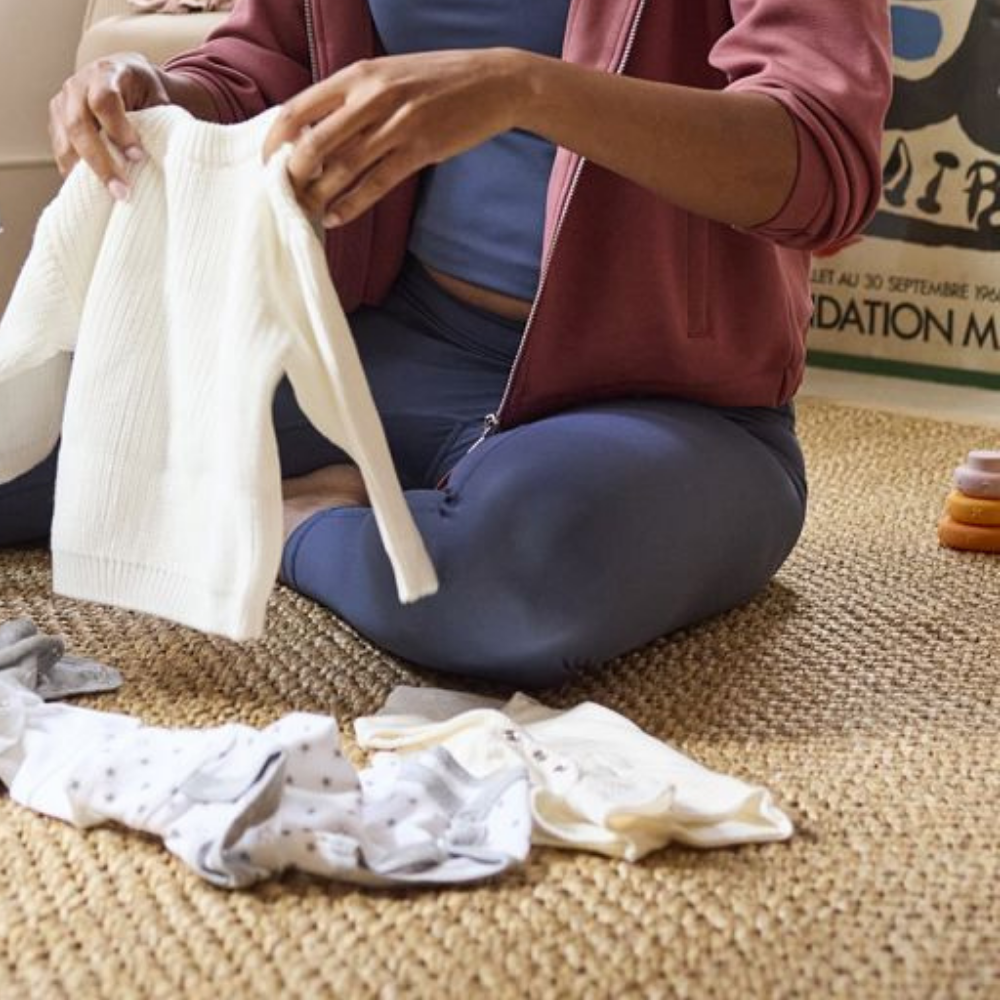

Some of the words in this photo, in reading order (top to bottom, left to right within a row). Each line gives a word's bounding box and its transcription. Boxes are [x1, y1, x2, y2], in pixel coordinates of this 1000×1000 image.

[810, 269, 834, 285] LET
[838, 272, 860, 288] AU
[888, 276, 969, 299] SEPTEMBRE
